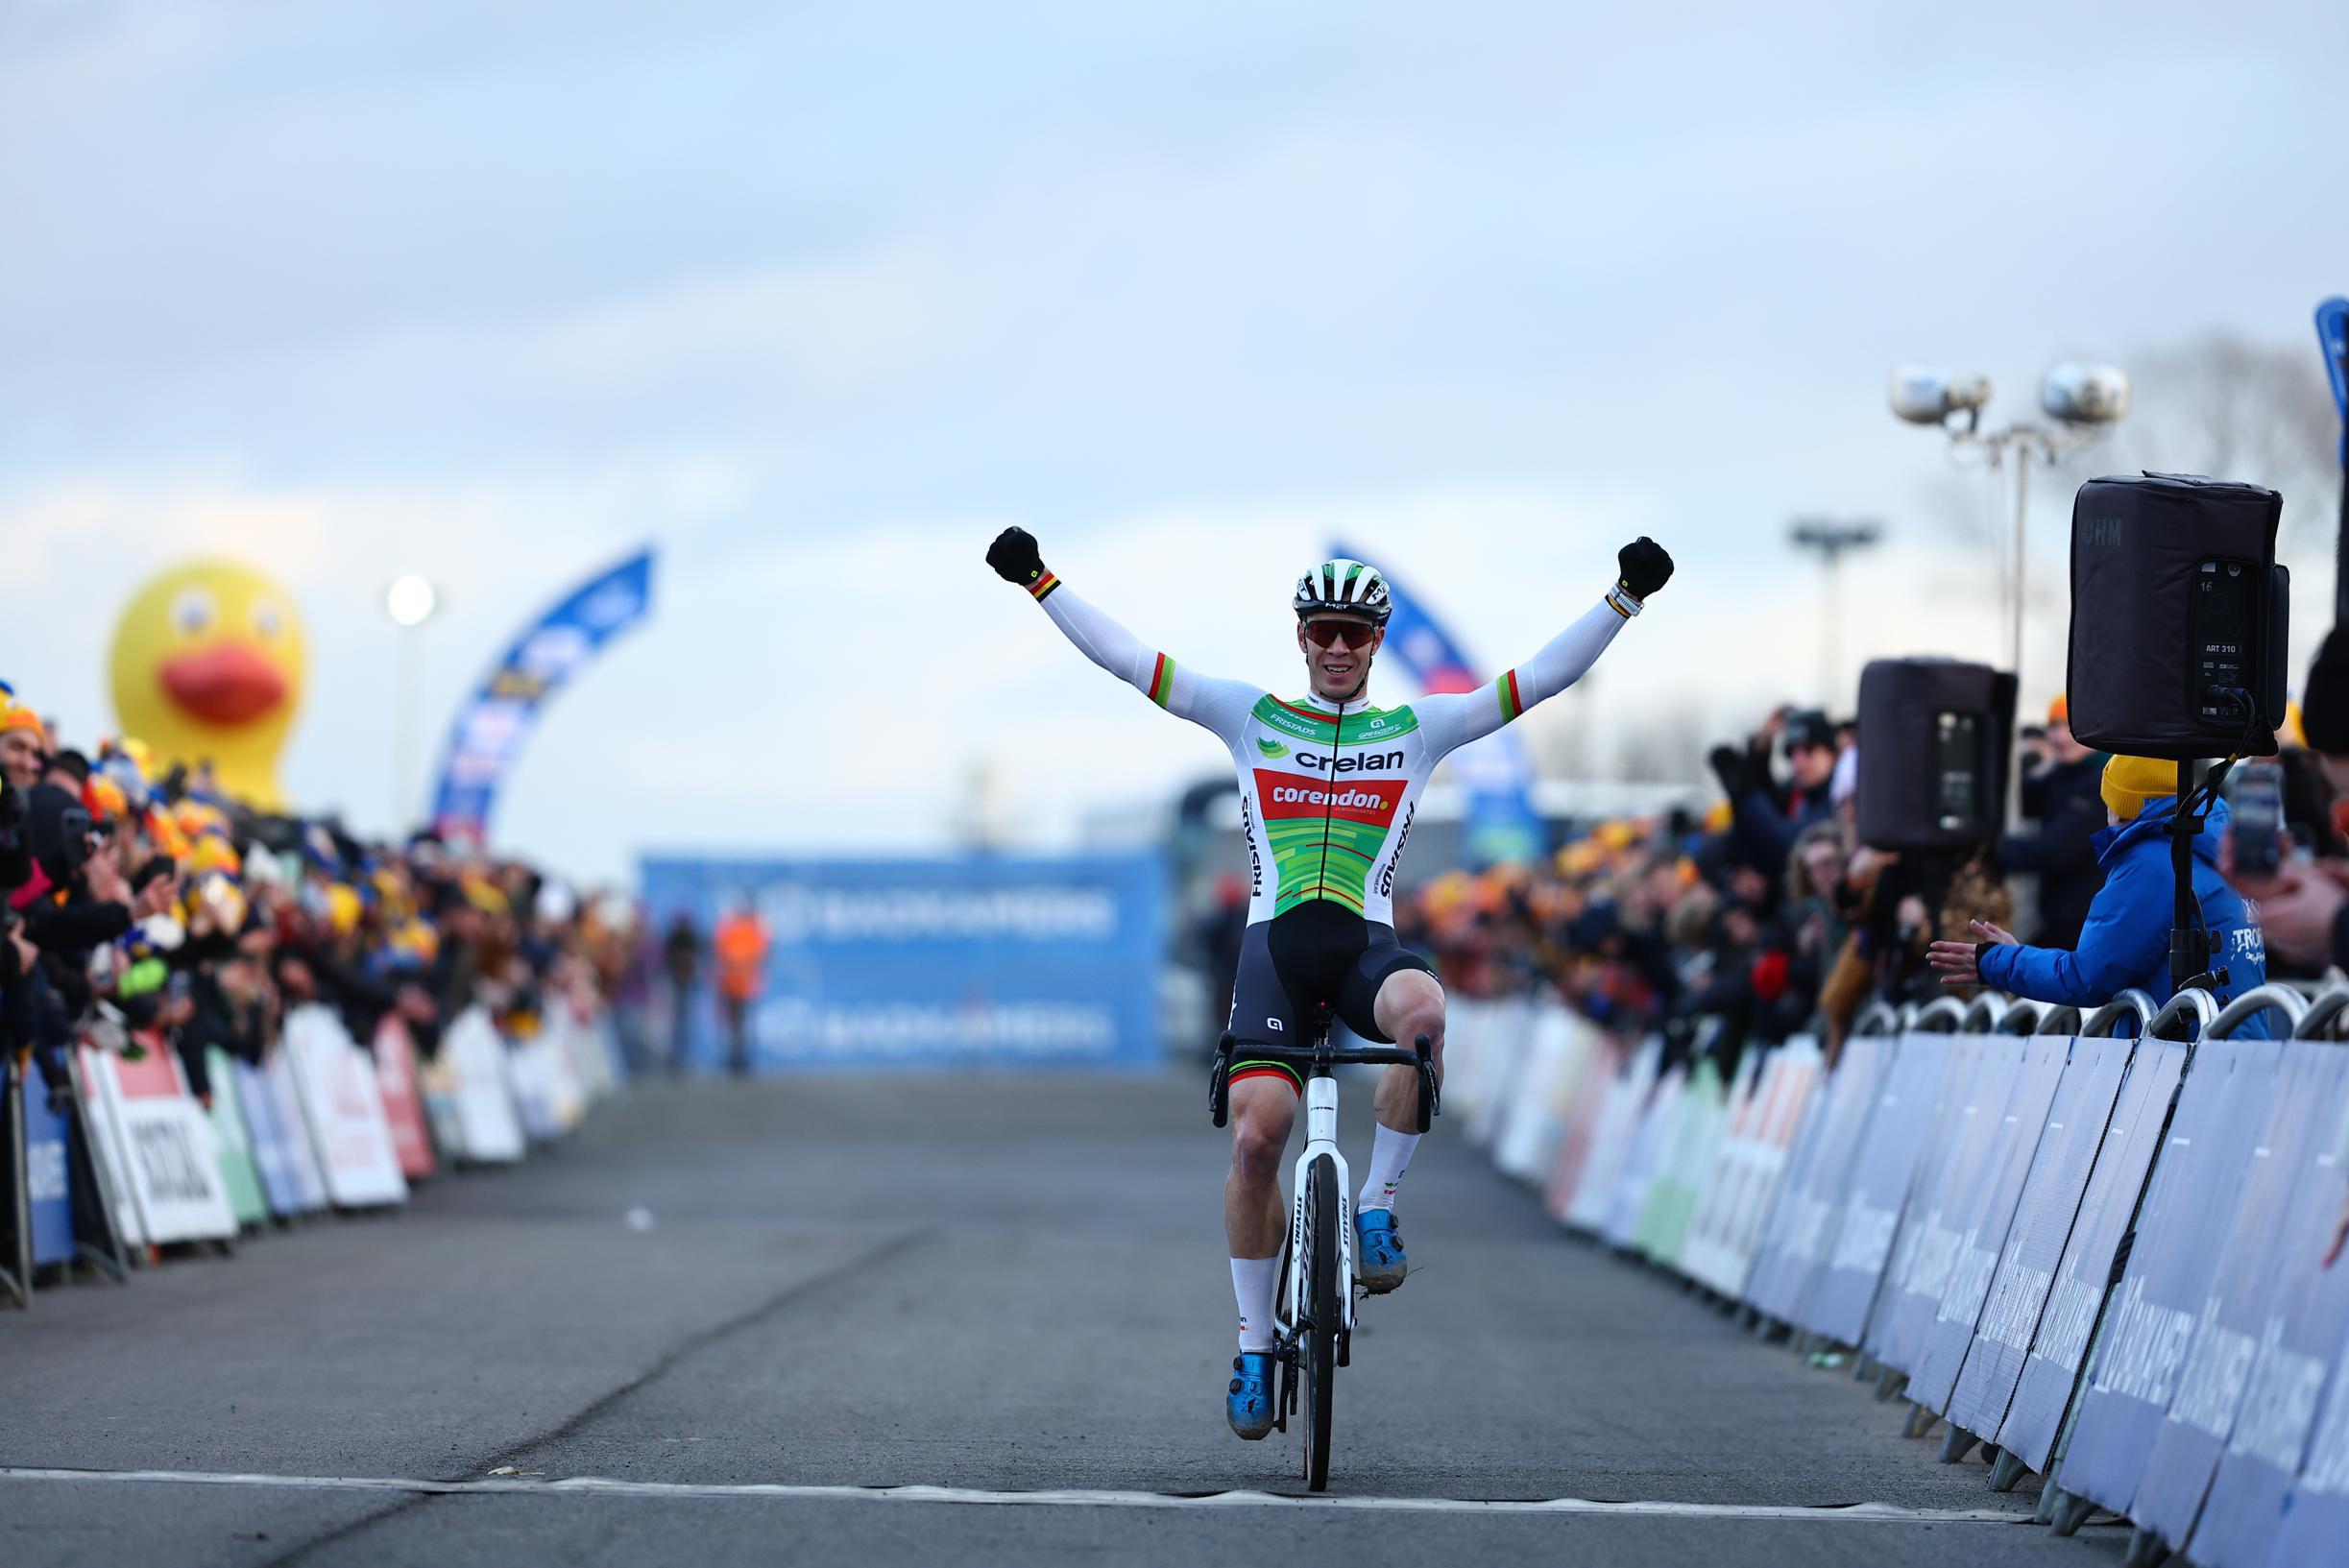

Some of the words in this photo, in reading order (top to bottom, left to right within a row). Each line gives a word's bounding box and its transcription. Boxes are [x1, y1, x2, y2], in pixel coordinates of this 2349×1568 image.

[1324, 602, 1349, 611] MET
[2206, 644, 2219, 653] ART
[1270, 713, 1317, 736] FRISTADS
[1296, 751, 1404, 772] crelan
[1241, 795, 1263, 897] FRISTADS
[1380, 800, 1415, 899] FRISTADS
